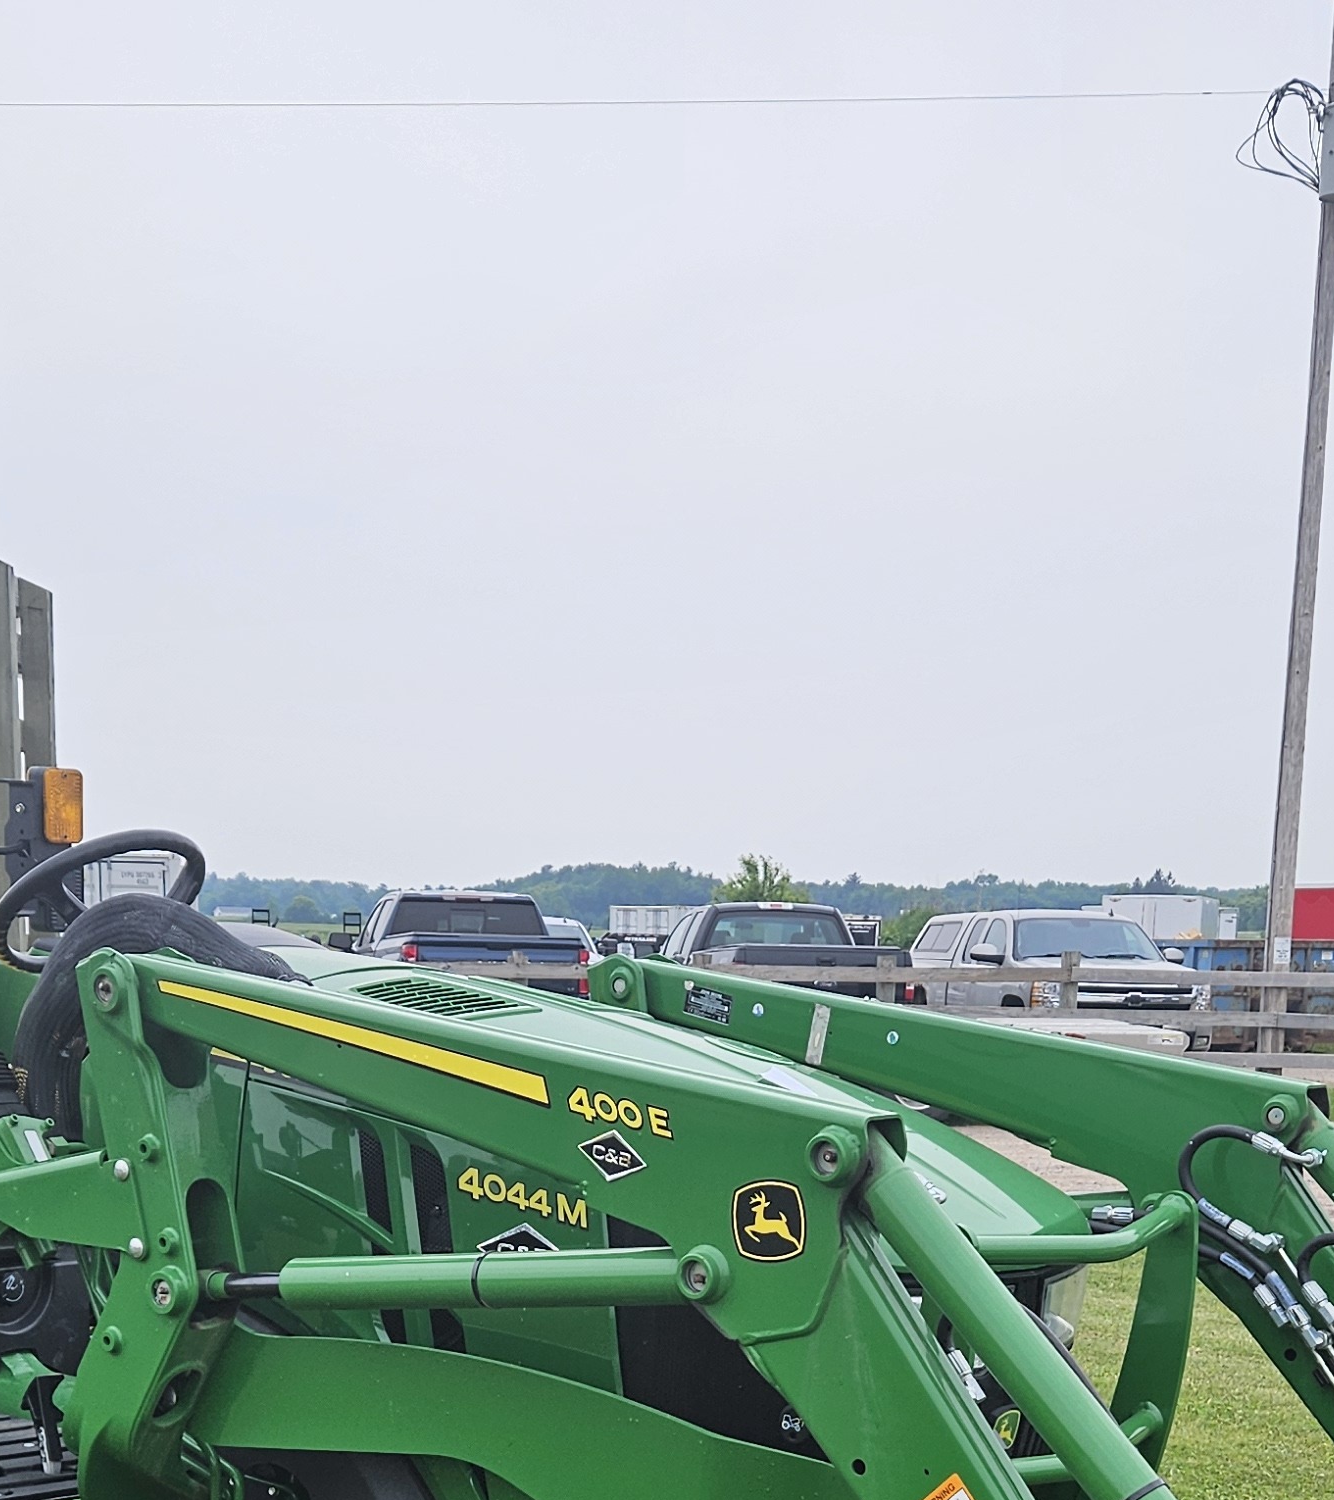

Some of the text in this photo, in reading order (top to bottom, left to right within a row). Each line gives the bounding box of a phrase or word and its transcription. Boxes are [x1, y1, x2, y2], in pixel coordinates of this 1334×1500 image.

[567, 1086, 673, 1139] 400 E
[457, 1166, 588, 1229] 4044 M
